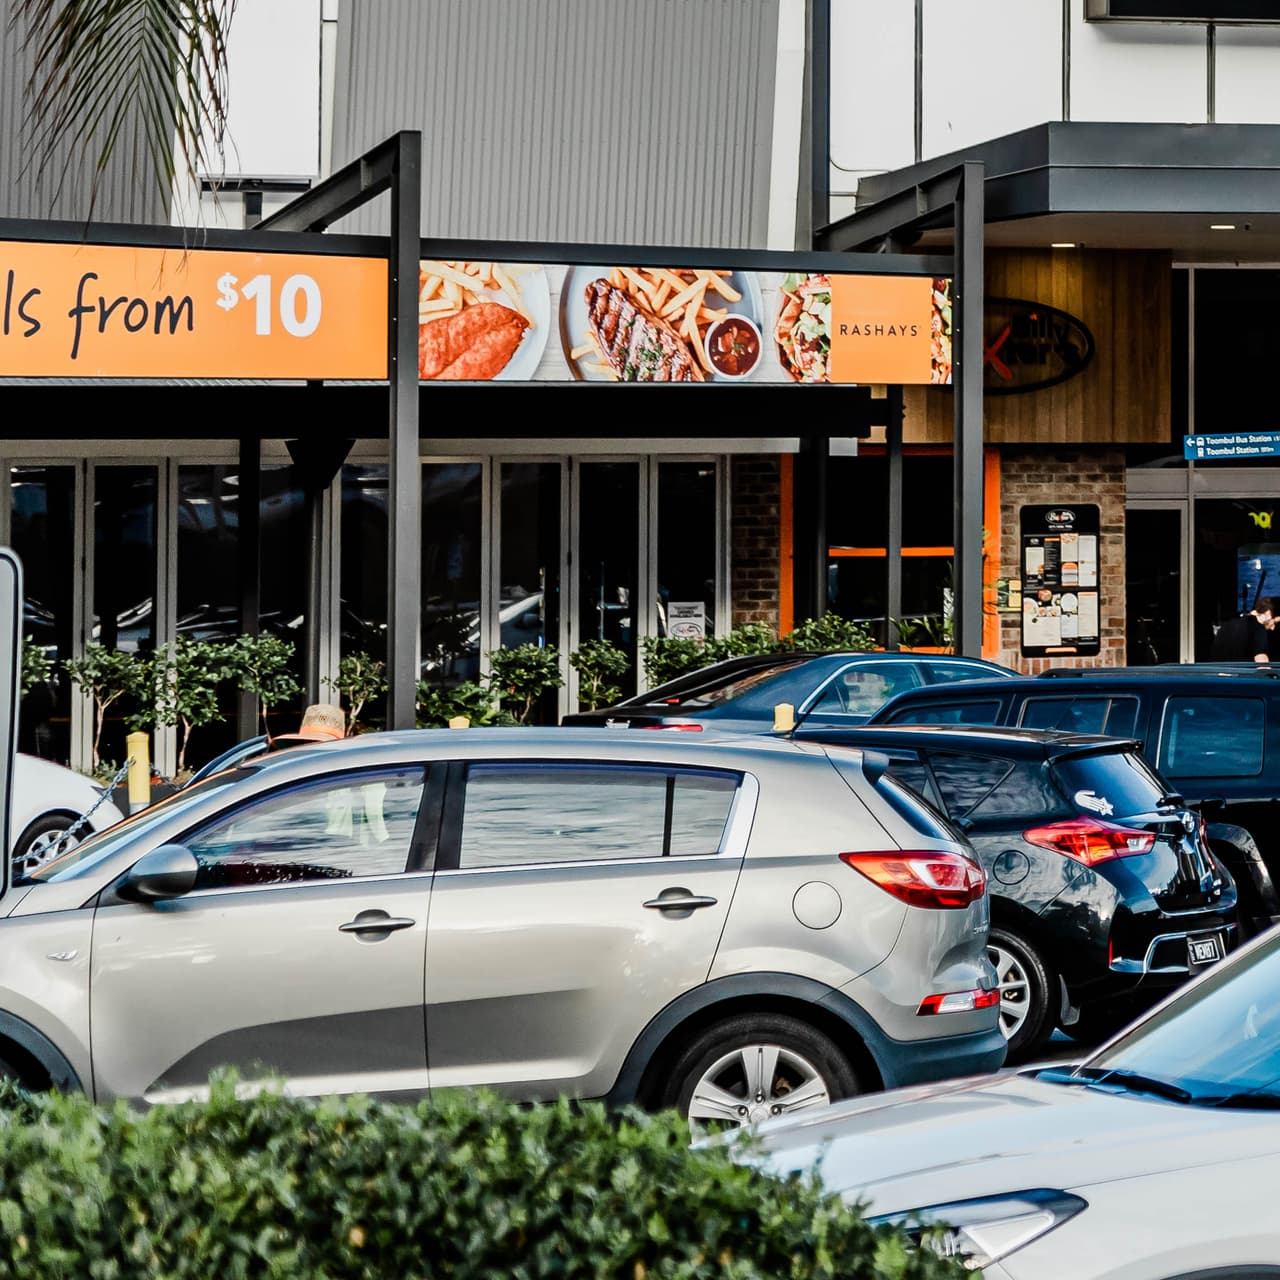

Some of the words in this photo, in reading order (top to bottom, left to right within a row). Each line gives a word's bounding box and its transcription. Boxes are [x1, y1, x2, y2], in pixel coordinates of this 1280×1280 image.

[68, 272, 194, 360] from
[216, 272, 322, 338] $10
[839, 323, 918, 337] RASHAYS
[1206, 436, 1235, 445] Toombul
[1249, 434, 1272, 443] Station
[1206, 446, 1235, 455] Toombul
[1236, 445, 1260, 454] Station
